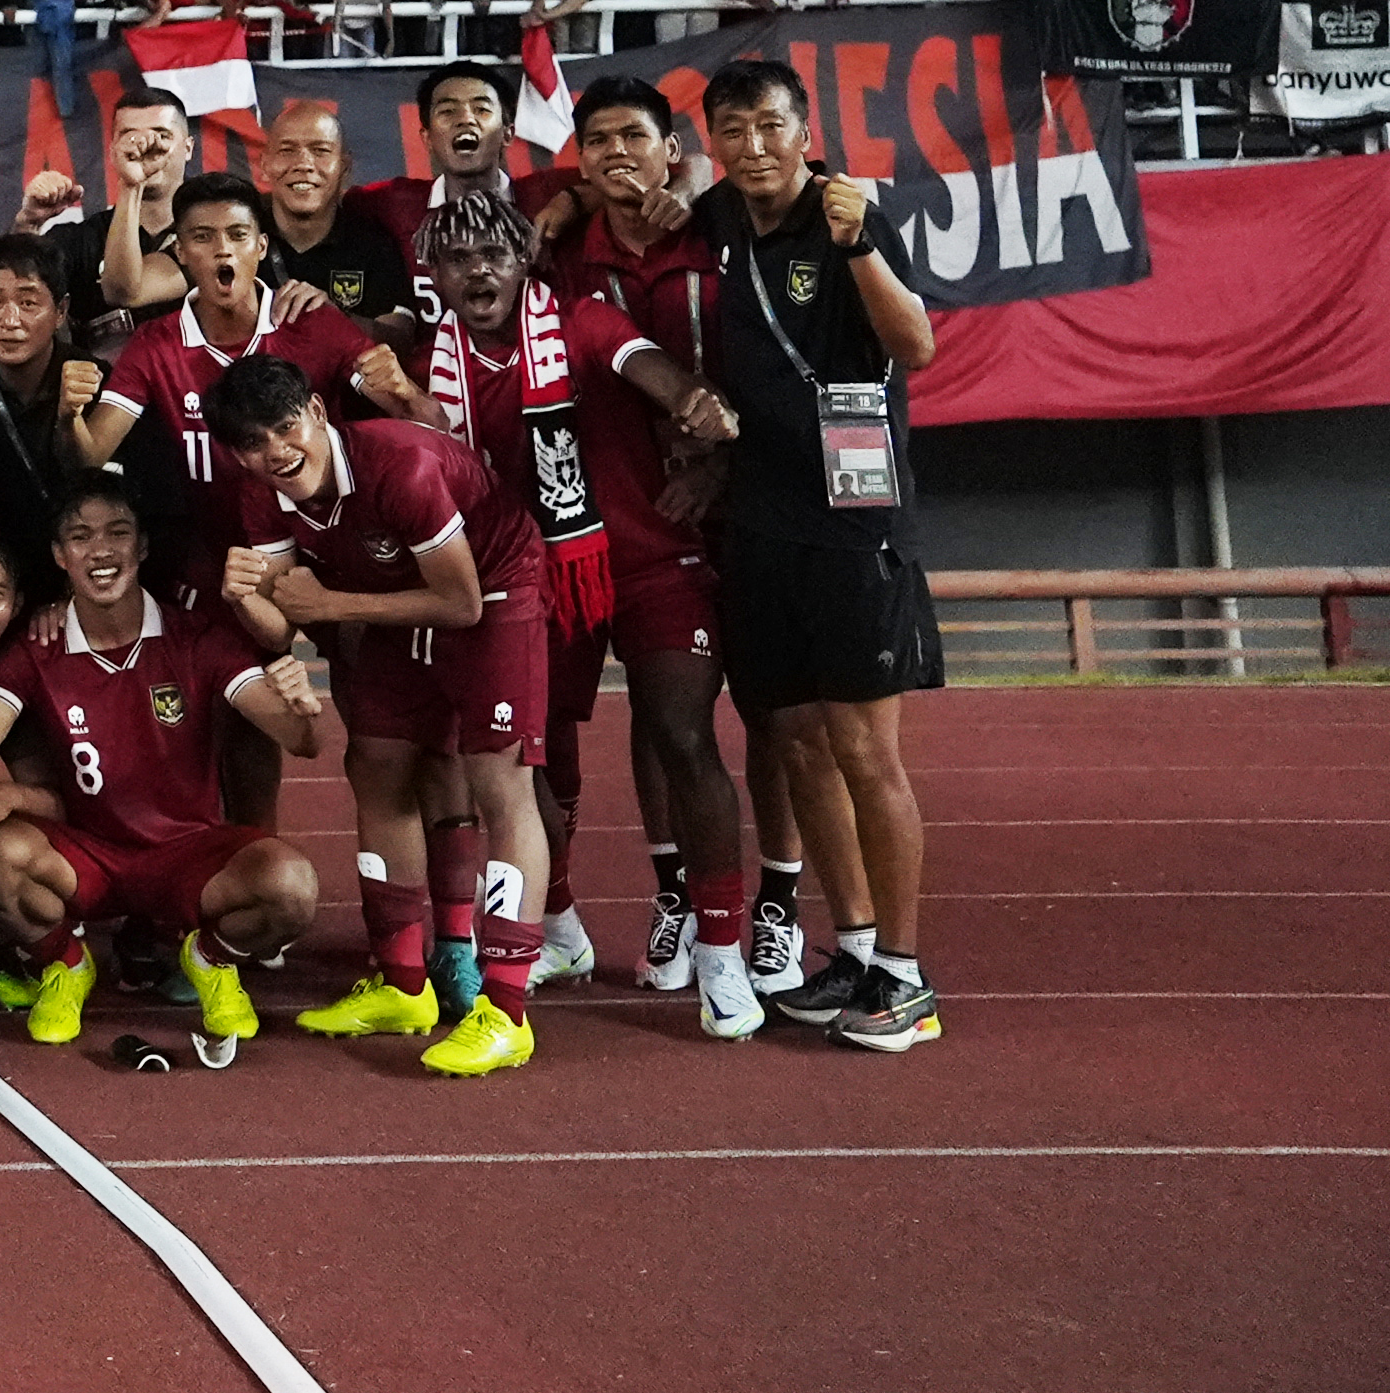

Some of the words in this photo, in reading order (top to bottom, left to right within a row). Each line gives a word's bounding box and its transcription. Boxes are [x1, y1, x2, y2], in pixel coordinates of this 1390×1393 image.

[413, 276, 442, 324] 5
[182, 430, 213, 483] 11
[71, 741, 104, 796] 8
